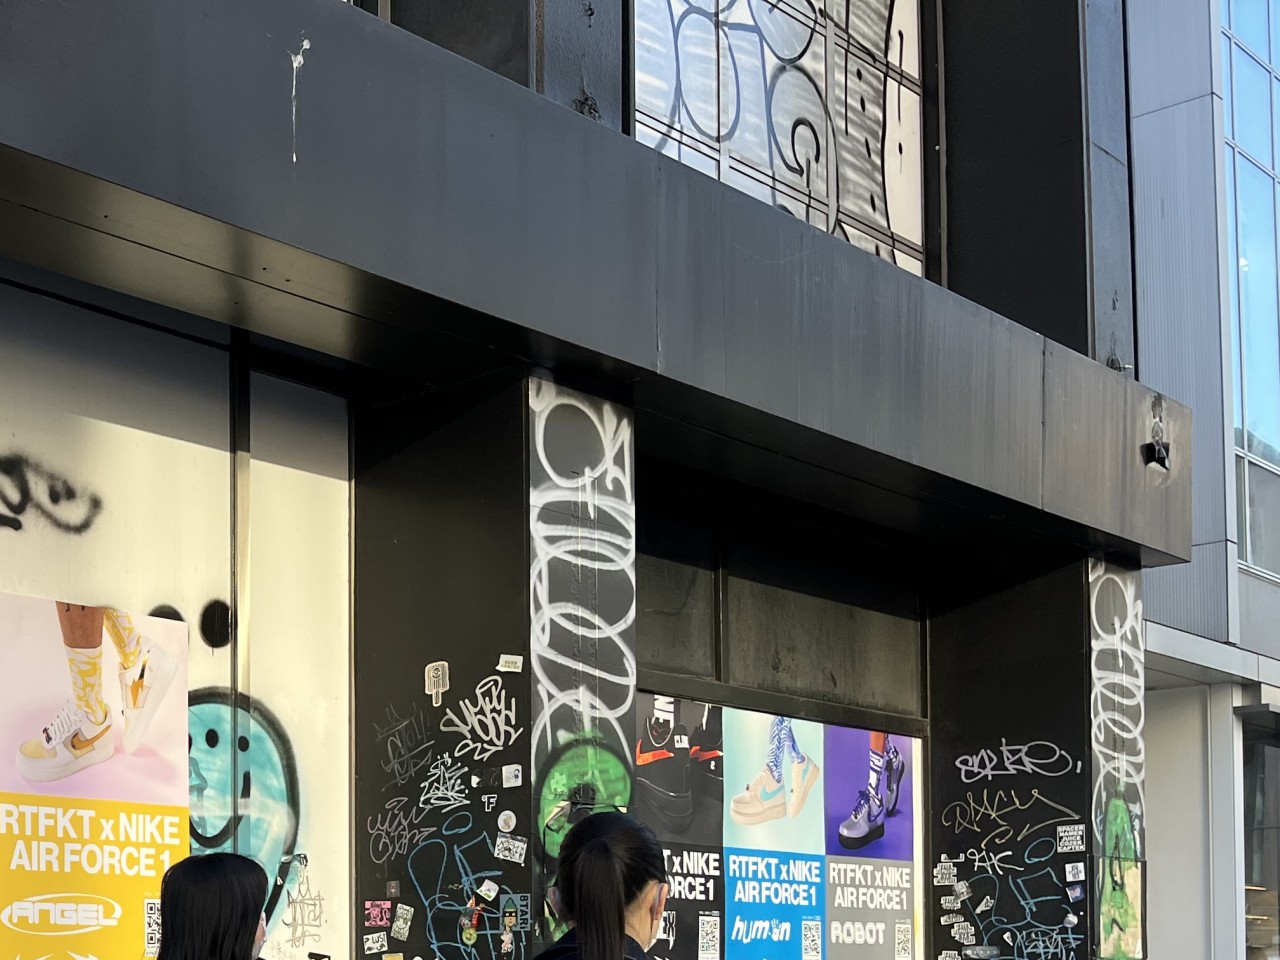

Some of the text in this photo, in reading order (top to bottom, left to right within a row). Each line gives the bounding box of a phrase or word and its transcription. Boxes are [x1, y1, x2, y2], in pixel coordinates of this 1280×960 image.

[0, 803, 180, 845] RTFKT x NIKE
[9, 840, 170, 877] AIR FORCE 1
[672, 855, 681, 870] x
[682, 850, 720, 876] NIKE
[729, 855, 821, 883] RTFKT x NIKE
[829, 863, 873, 886] RTFKT
[874, 871, 883, 887] x
[882, 866, 911, 889] NIKE
[706, 878, 715, 901] 1
[734, 881, 816, 906] AIR FORCE 1
[834, 886, 908, 910] AIR FORCE 1
[11, 900, 119, 926] ANGEL
[830, 920, 885, 944] ROBOT
